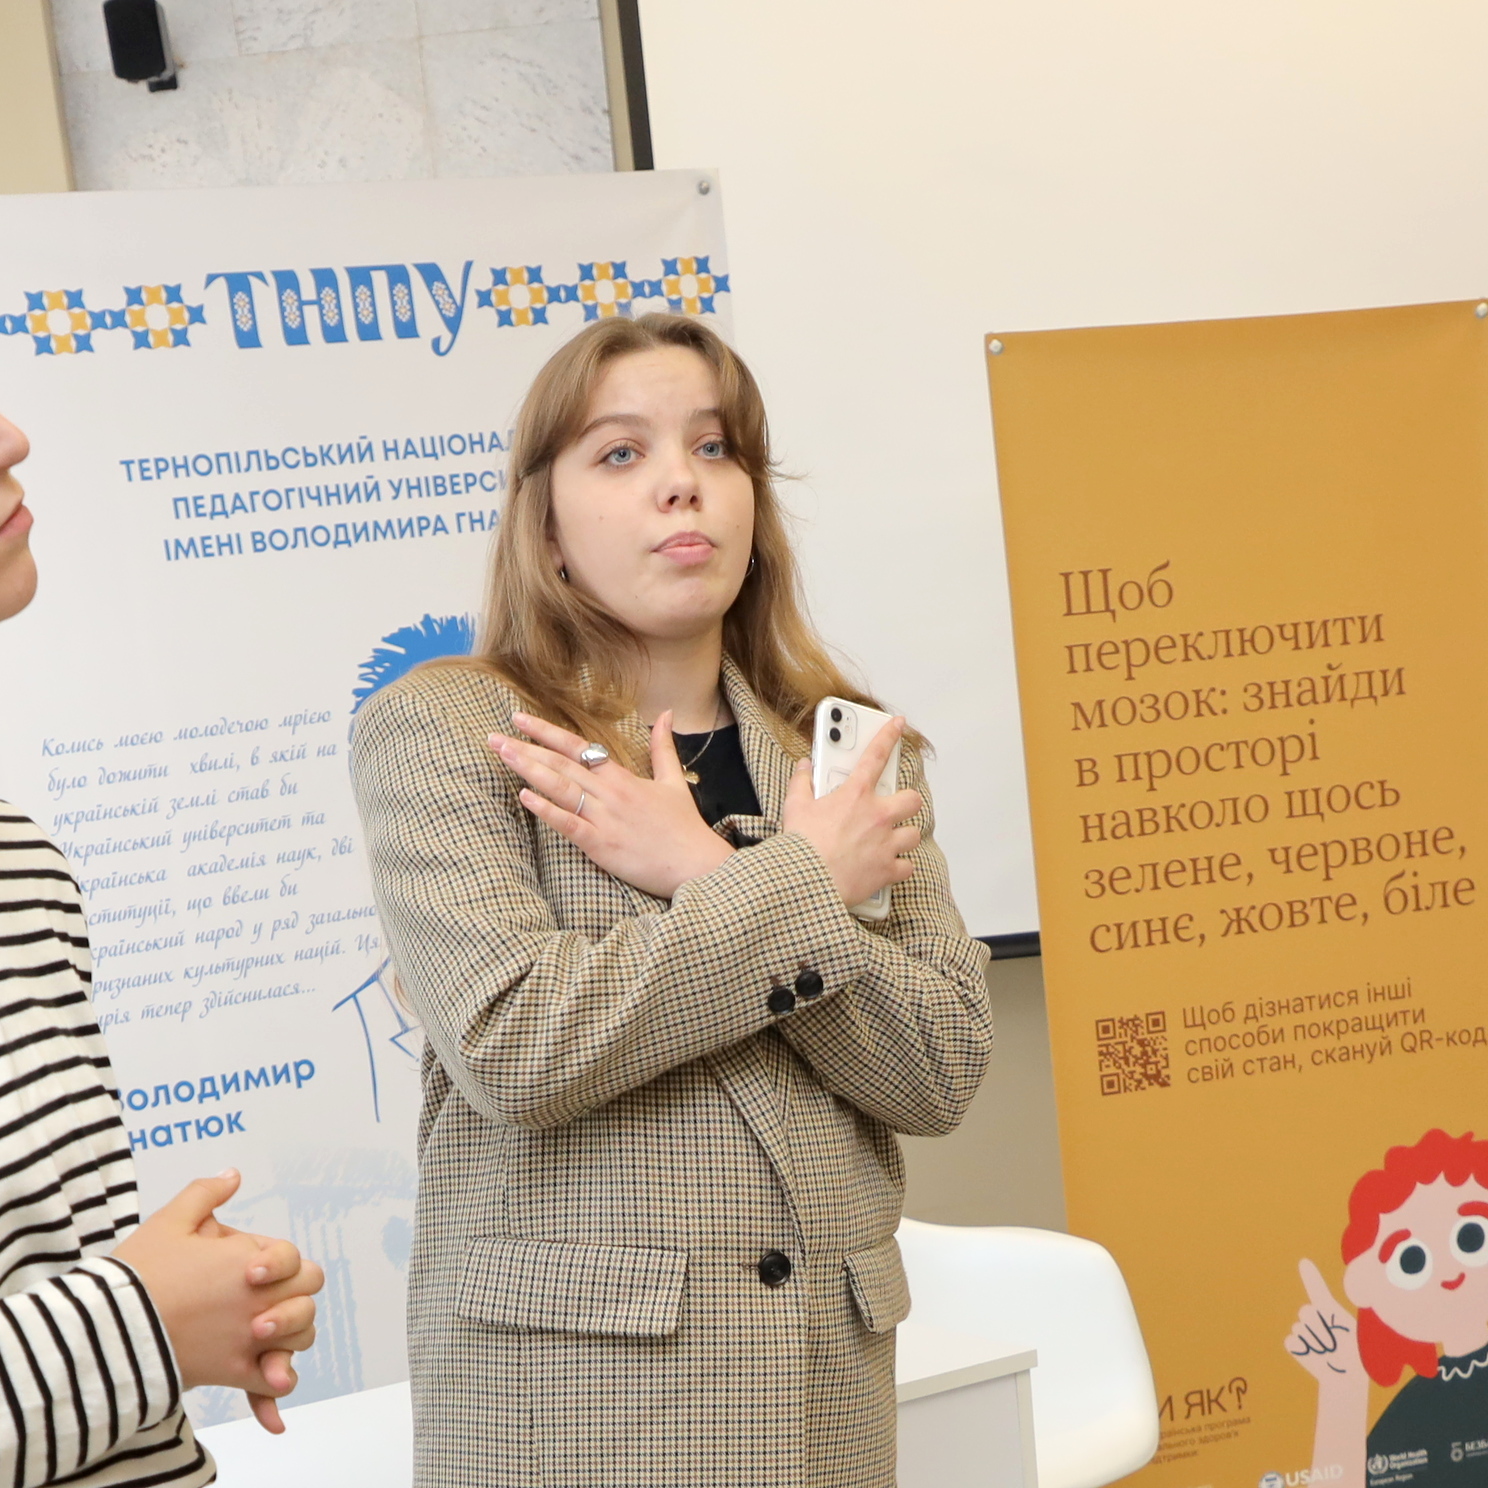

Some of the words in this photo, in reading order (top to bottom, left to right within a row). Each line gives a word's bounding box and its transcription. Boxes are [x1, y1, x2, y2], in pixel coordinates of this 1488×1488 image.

[205, 260, 474, 357] ТНПУ
[119, 435, 375, 482] ТЕРНОПІЛЬСЬКИЙ
[382, 429, 515, 462] НАЦІОНАЛ
[172, 475, 381, 520] ПЕДАГОГІЧНИЙ
[387, 469, 507, 501] УНІВЕРСИ
[164, 533, 243, 561] ІМЕНІ
[250, 514, 449, 553] ВОЛОДИМИРА
[455, 508, 500, 534] ГНА
[1059, 560, 1173, 623] Щоб
[1065, 614, 1384, 681] переключити
[1071, 687, 1227, 731] мозок:
[1244, 663, 1406, 712] знайди
[42, 738, 104, 757] Колись
[114, 731, 163, 748] моєю
[173, 717, 269, 740] молодечою
[278, 709, 331, 735] мрією
[1074, 758, 1099, 787] в
[1114, 717, 1320, 793] просторі
[48, 767, 87, 801] було
[98, 764, 168, 785] дожити
[190, 752, 240, 774] хвилі,
[251, 746, 260, 766] в
[269, 743, 307, 763] якій
[317, 744, 337, 757] на
[50, 796, 160, 837] українській
[166, 789, 218, 820] землі
[228, 779, 270, 803] став
[280, 772, 298, 796] би
[180, 815, 292, 853] університет
[301, 811, 326, 826] та
[1079, 794, 1269, 843] навколо
[1284, 780, 1400, 822] щось
[76, 867, 168, 900] країнська
[187, 852, 266, 877] академія
[276, 847, 321, 871] наук,
[332, 836, 353, 856] дві
[1085, 853, 1253, 899] зелене,
[1267, 826, 1466, 881] червоне,
[88, 898, 177, 929] ституції,
[187, 897, 213, 917] що
[223, 885, 270, 906] ввели
[280, 874, 298, 897] би
[1090, 913, 1205, 953] синє,
[1220, 893, 1368, 937] жовте,
[1383, 870, 1475, 915] біле
[91, 928, 185, 969] країнський
[195, 919, 243, 950] народ
[251, 922, 263, 944] у
[271, 911, 299, 941] ряд
[93, 969, 174, 1000] ризнаних
[183, 953, 285, 987] культурних
[294, 939, 345, 964] націй.
[355, 934, 380, 957] Ця
[141, 1001, 192, 1023] тепер
[199, 983, 315, 1018] здійснилася...
[1183, 1001, 1235, 1031] Щоб
[1244, 989, 1359, 1025] дізнатися
[1367, 977, 1413, 1004] інші
[1185, 1024, 1285, 1056] способи
[1294, 1008, 1425, 1041] покращити
[1187, 1058, 1234, 1084] свій
[1243, 1053, 1302, 1076] стан,
[1311, 1035, 1392, 1066] скануй
[1401, 1026, 1488, 1053] QR-код
[118, 1058, 315, 1113] олодимир
[128, 1111, 246, 1152] натюк
[1159, 1395, 1174, 1421] И
[1286, 1463, 1344, 1488] USAID
